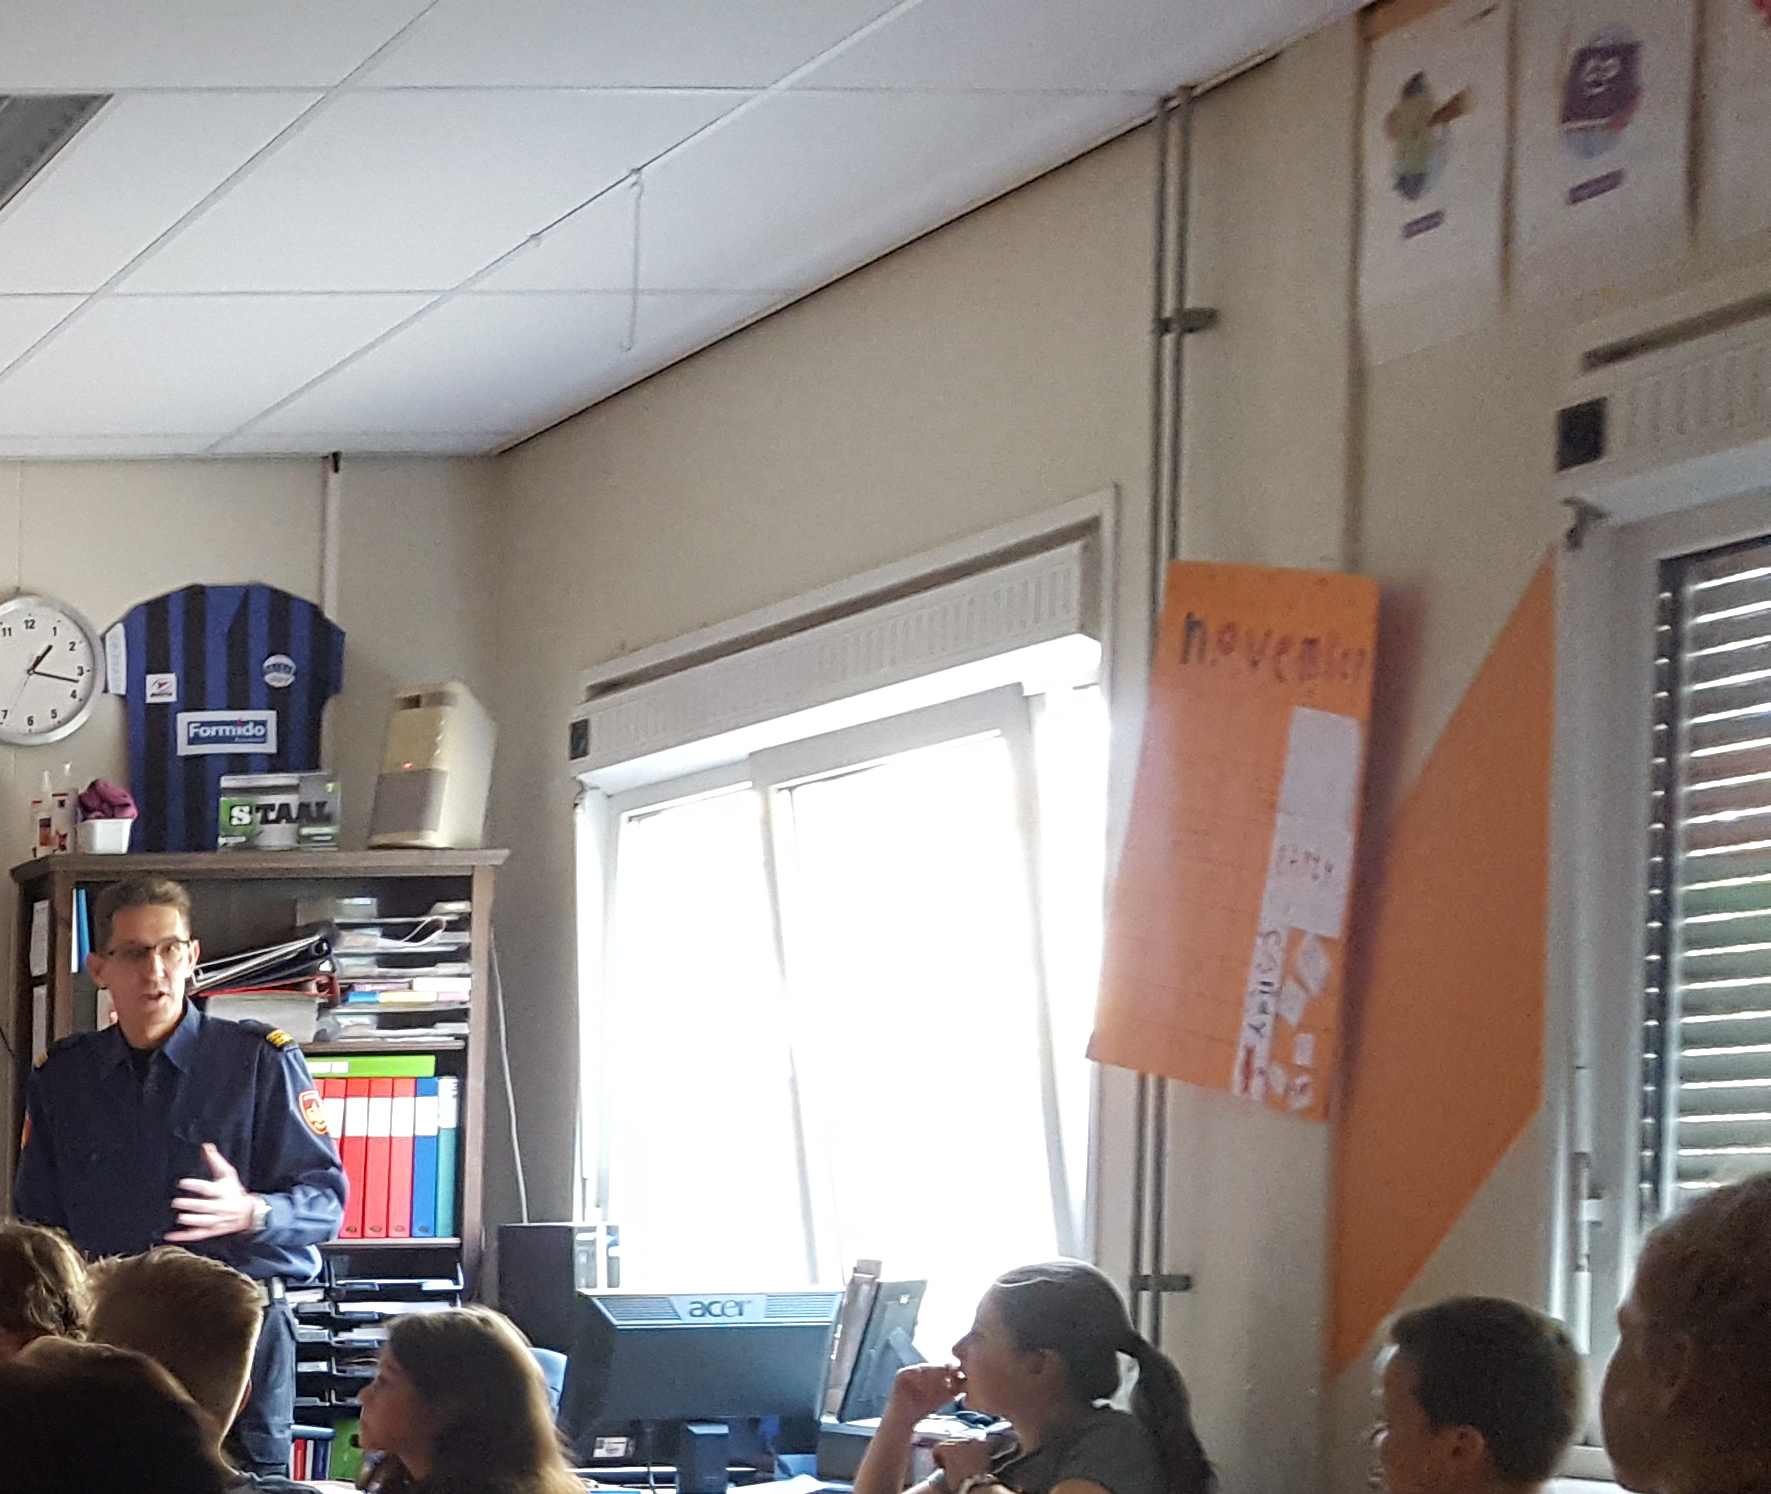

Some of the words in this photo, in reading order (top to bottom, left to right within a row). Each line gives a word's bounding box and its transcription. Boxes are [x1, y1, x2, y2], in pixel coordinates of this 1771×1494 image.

[23, 619, 36, 630] 12
[1, 626, 12, 637] 11
[68, 641, 76, 652] 2
[77, 665, 85, 676] 3
[70, 689, 77, 700] 4
[1, 709, 9, 720] 7
[50, 708, 58, 719] 5
[27, 715, 34, 726] 6
[189, 720, 266, 738] Formido
[228, 800, 335, 825] STAAL
[689, 1299, 752, 1318] acer
